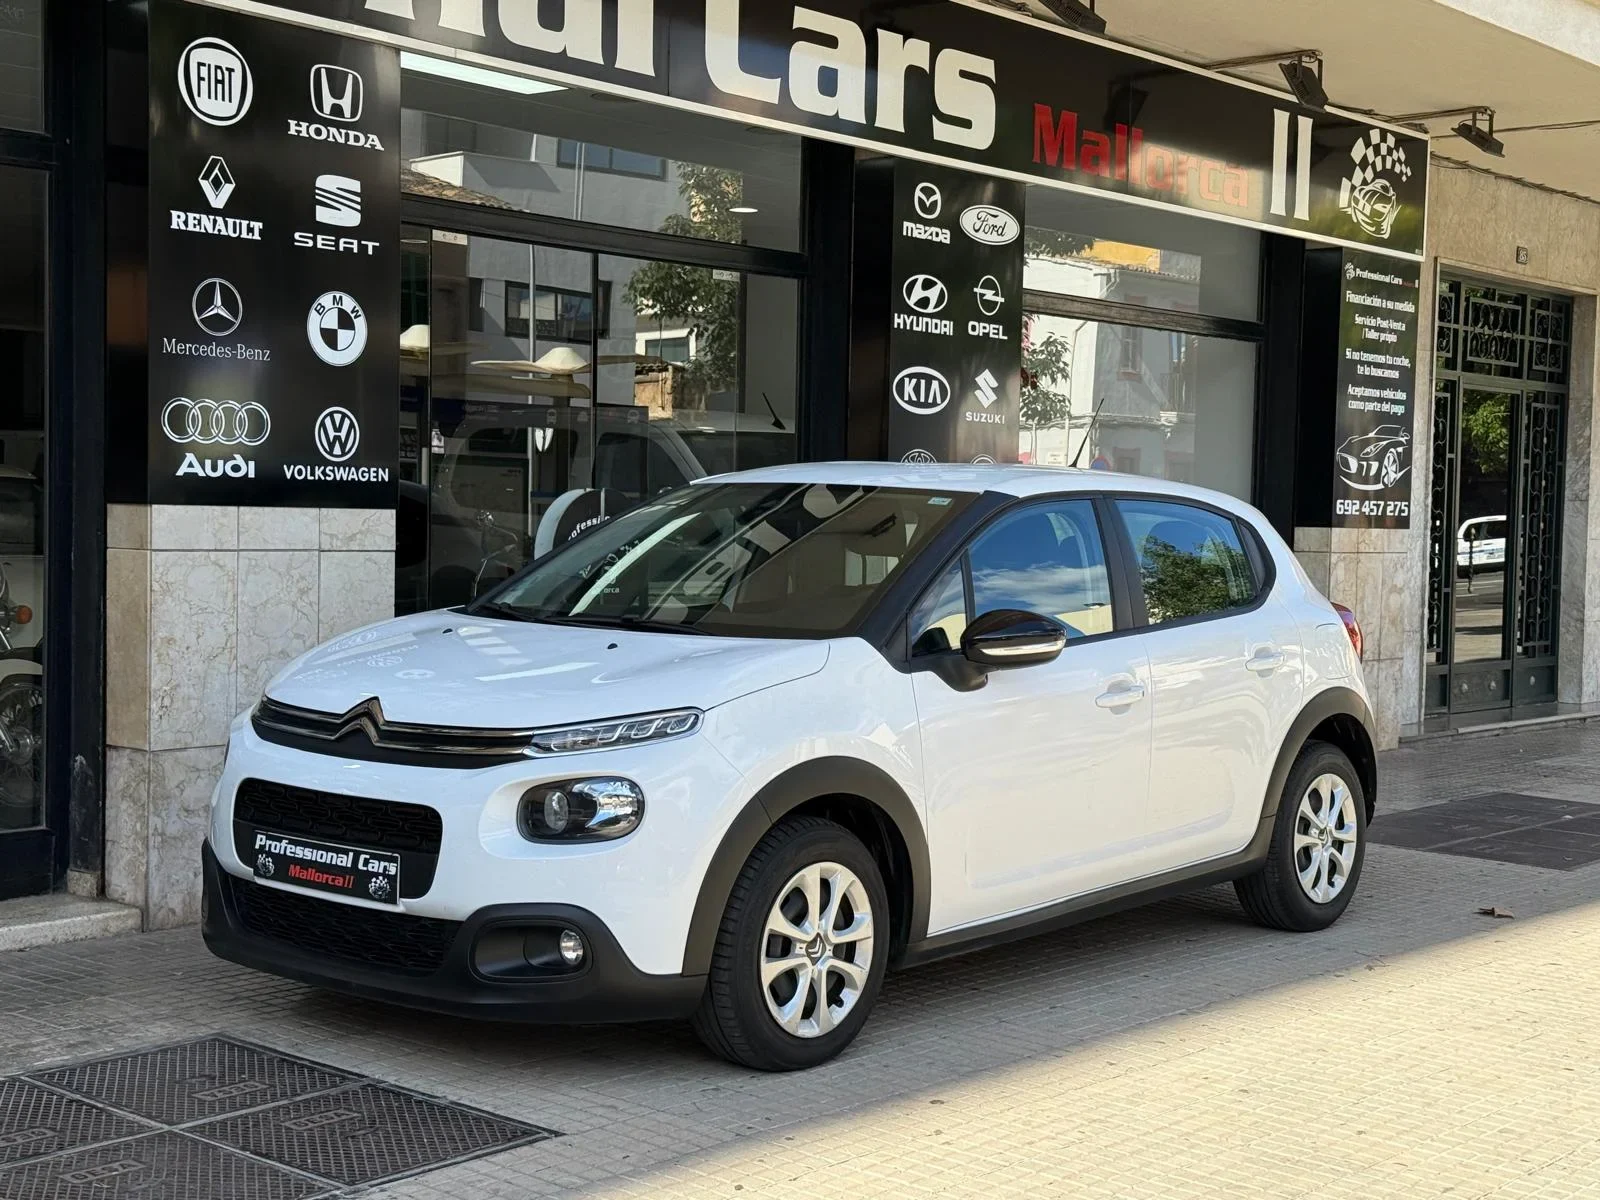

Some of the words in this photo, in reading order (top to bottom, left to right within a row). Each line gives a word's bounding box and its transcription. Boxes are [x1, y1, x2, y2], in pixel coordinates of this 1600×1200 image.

[196, 61, 236, 105] FIAT
[288, 119, 384, 151] HONDA
[1032, 103, 1249, 208] Mallorca
[170, 209, 263, 241] RENAULT
[972, 211, 1008, 237] Ford
[293, 231, 380, 256] SEAT
[1355, 267, 1390, 283] Professional
[314, 295, 363, 321] BMW
[894, 313, 954, 336] HYUNDAI
[967, 320, 1009, 340] OPEL
[162, 338, 271, 361] Mercedes-Benz
[1360, 350, 1386, 364] tenemos
[1370, 364, 1400, 379] buscamos
[903, 377, 942, 405] KIA
[1347, 383, 1380, 398] Aceptamos
[965, 411, 1006, 424] SUZUKI
[175, 453, 256, 478] Audi
[283, 464, 390, 482] VOLKSWAGEN
[1336, 499, 1360, 515] 692
[1361, 500, 1385, 516] 457
[1386, 501, 1409, 517] 275
[254, 834, 354, 868] Professional
[358, 854, 398, 876] Cars
